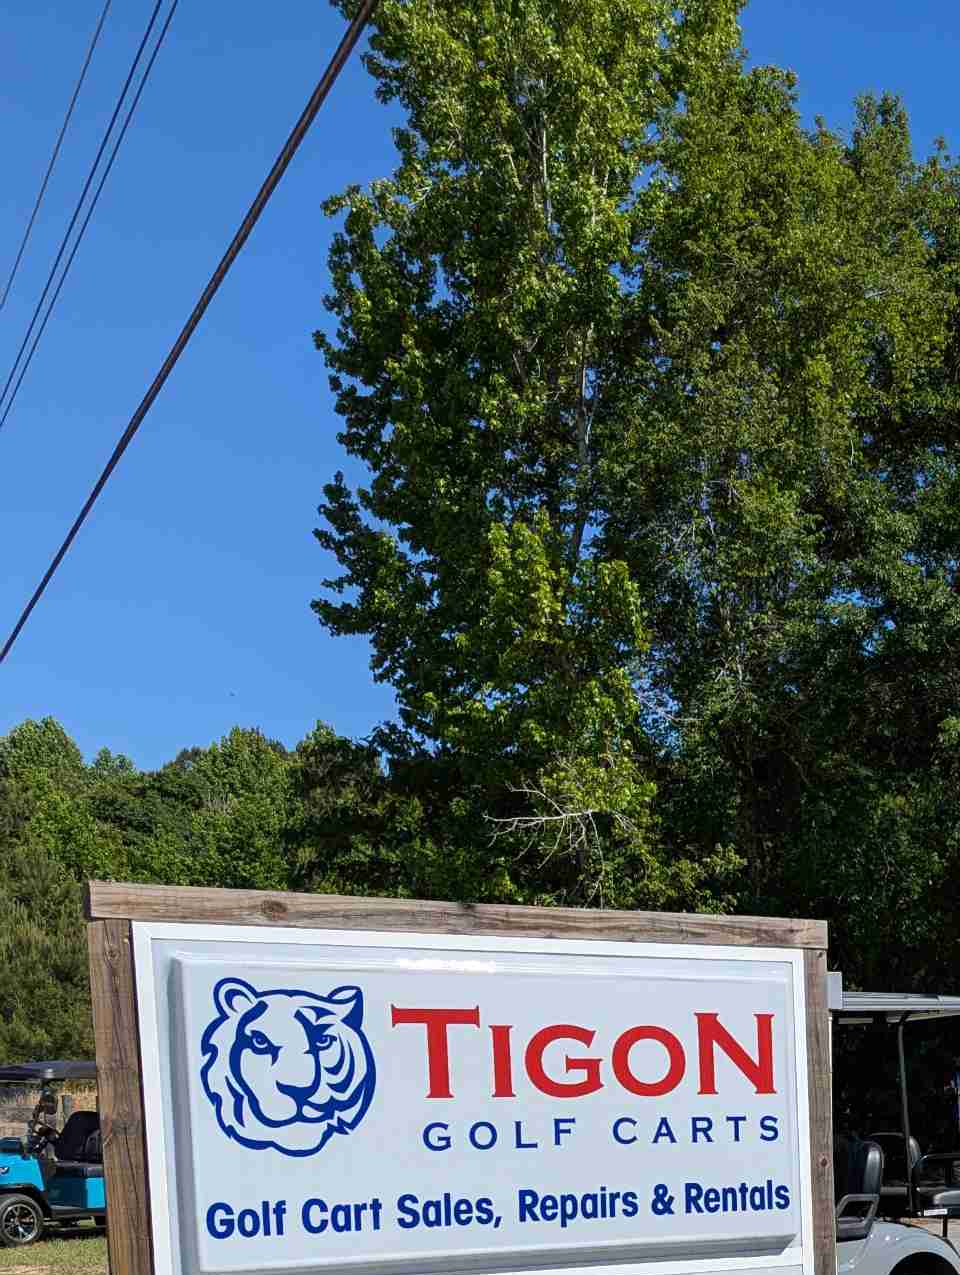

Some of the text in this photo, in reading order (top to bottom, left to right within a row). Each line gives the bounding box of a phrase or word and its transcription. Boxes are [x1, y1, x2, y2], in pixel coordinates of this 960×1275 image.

[391, 1004, 776, 1098] TIGON
[422, 1115, 780, 1152] GOLF CARTS
[205, 1179, 791, 1240] Golf Cart Sales, Repairs & Rentals
